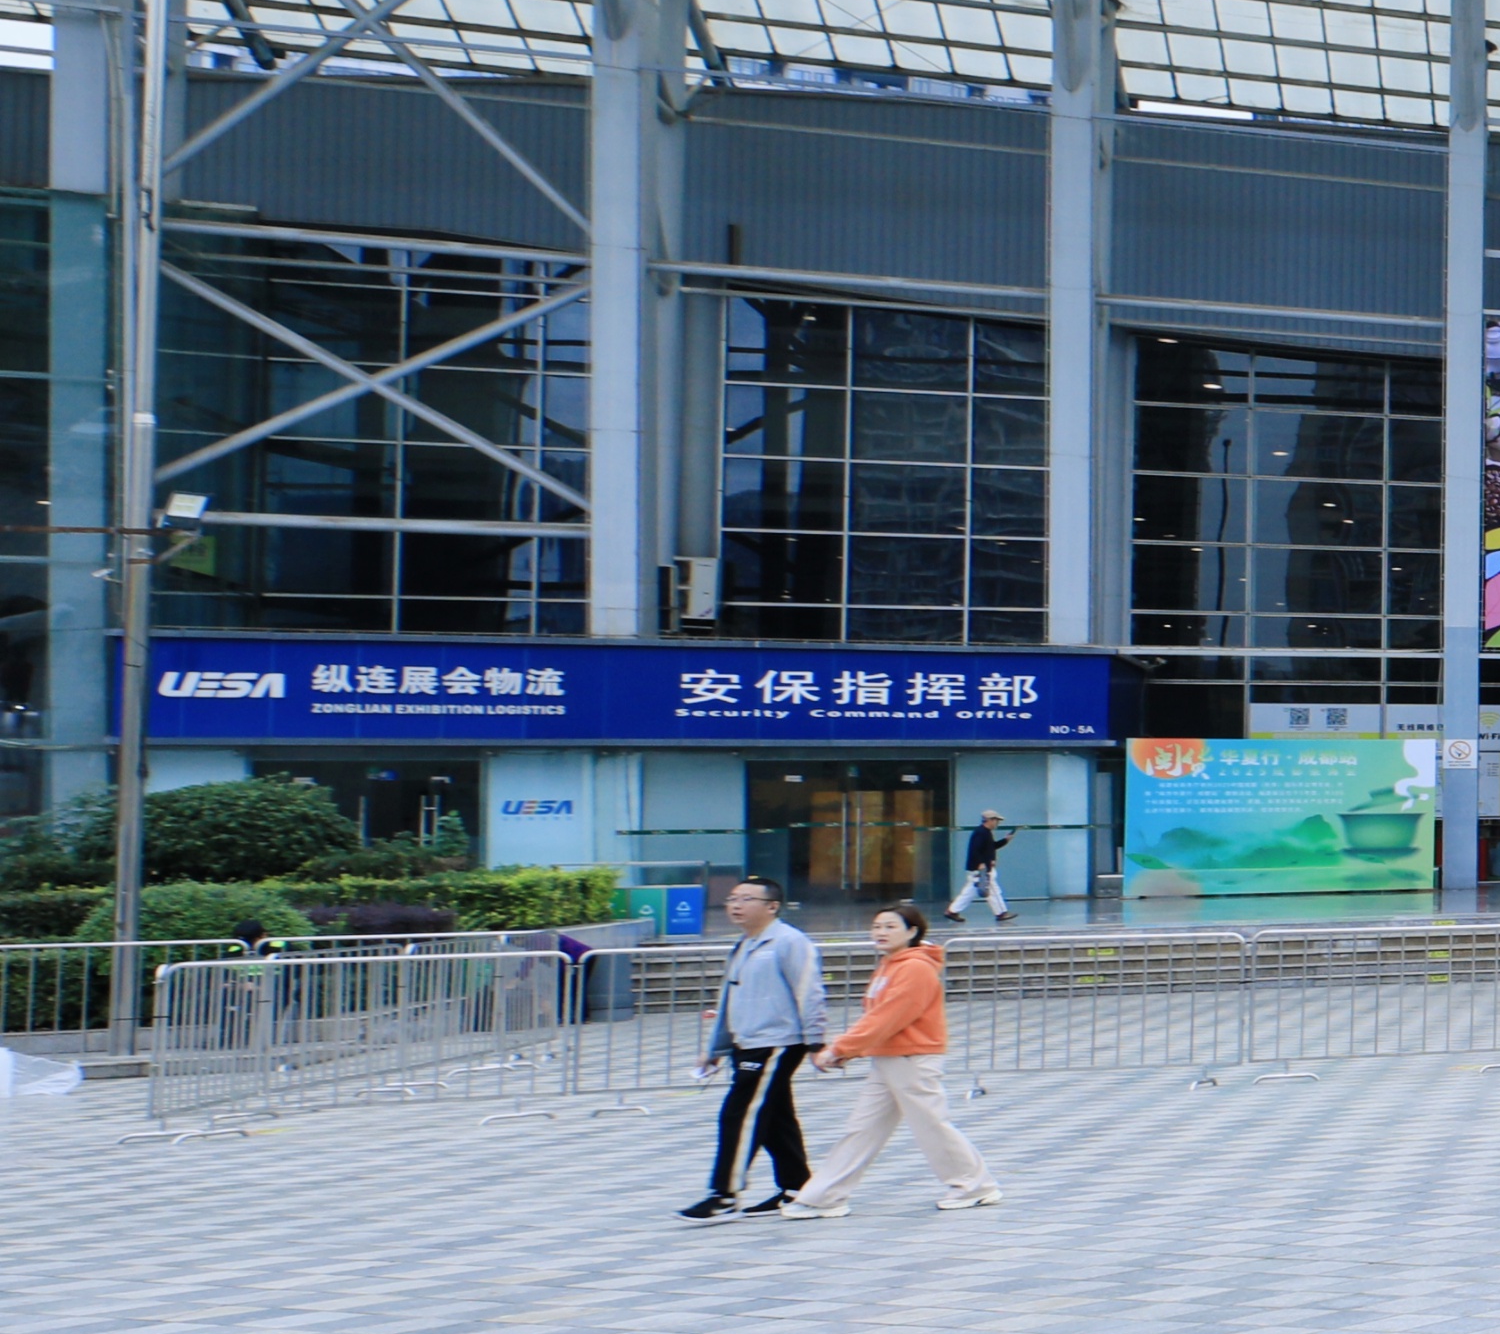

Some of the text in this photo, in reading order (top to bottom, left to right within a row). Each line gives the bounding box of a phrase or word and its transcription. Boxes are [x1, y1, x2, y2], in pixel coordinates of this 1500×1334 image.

[158, 671, 286, 698] UESA
[311, 664, 566, 696] 纵连展会物流
[680, 669, 1038, 707] 安保指挥部
[311, 702, 566, 716] ZONGLIAN EXHIBITION LOGISTICS
[675, 708, 1033, 720] Security Command Office
[501, 800, 574, 815] UESA
